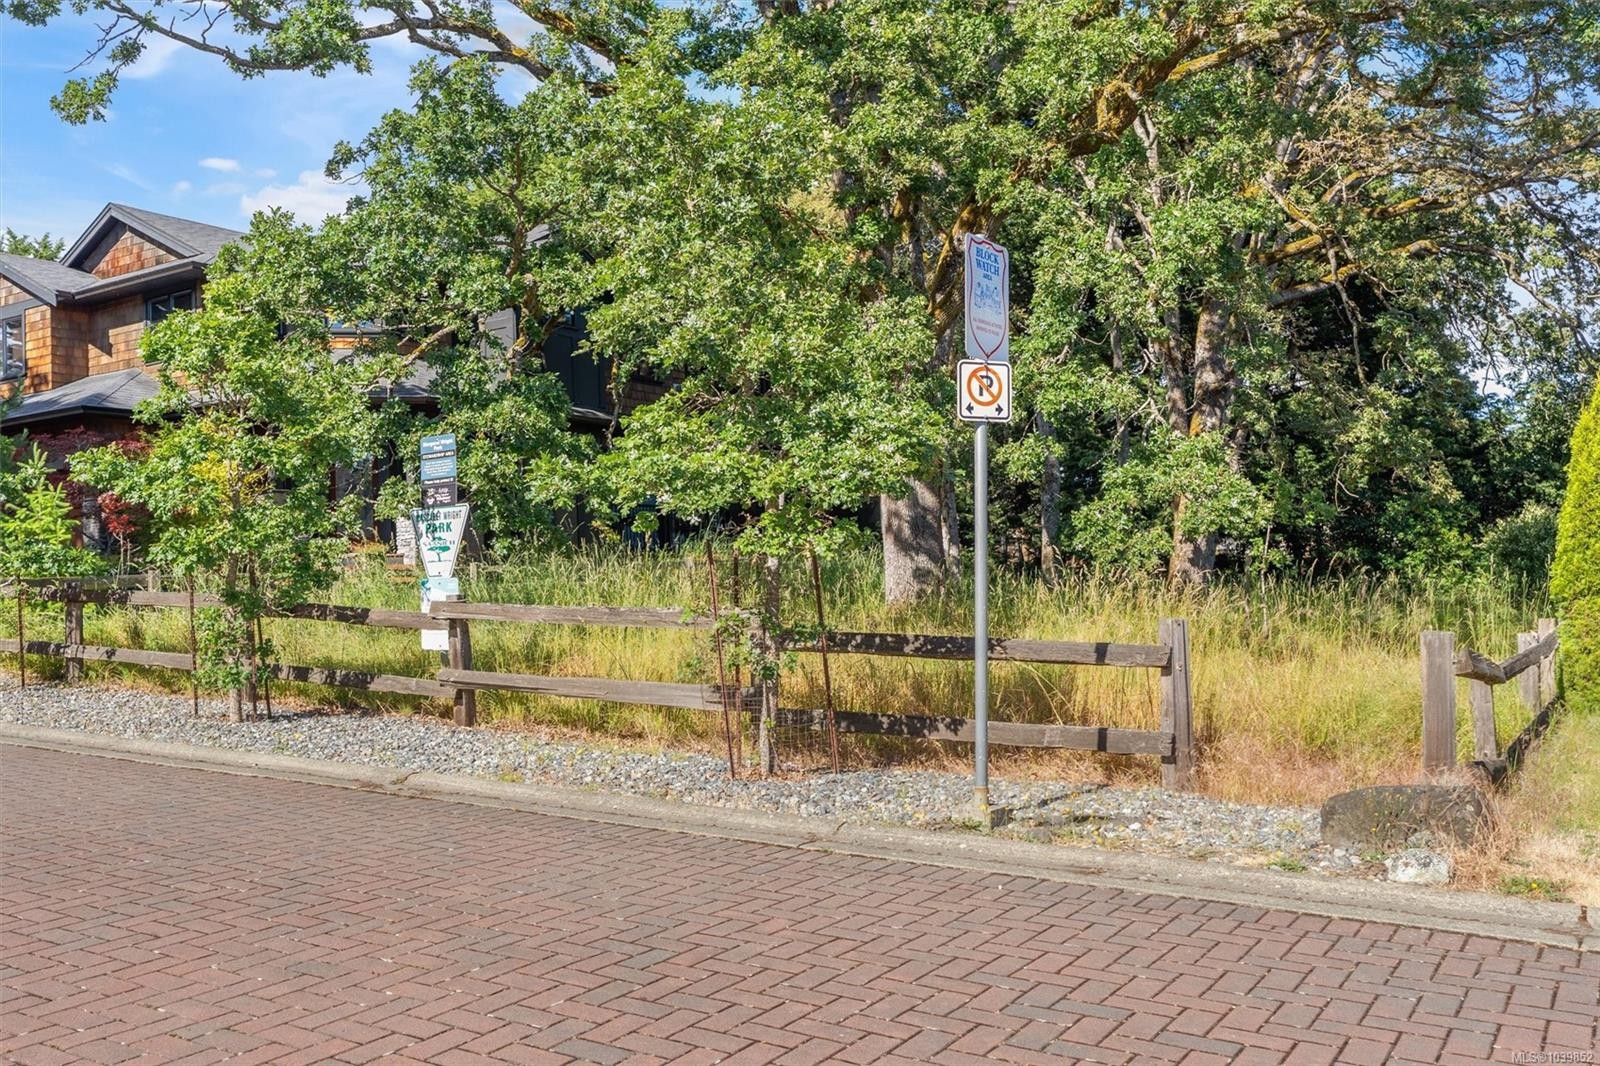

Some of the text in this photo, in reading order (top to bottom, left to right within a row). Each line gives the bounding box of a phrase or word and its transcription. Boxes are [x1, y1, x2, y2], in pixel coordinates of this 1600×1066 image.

[976, 246, 999, 265] BLOCK
[976, 258, 1000, 277] WATCH
[425, 522, 452, 533] PARK
